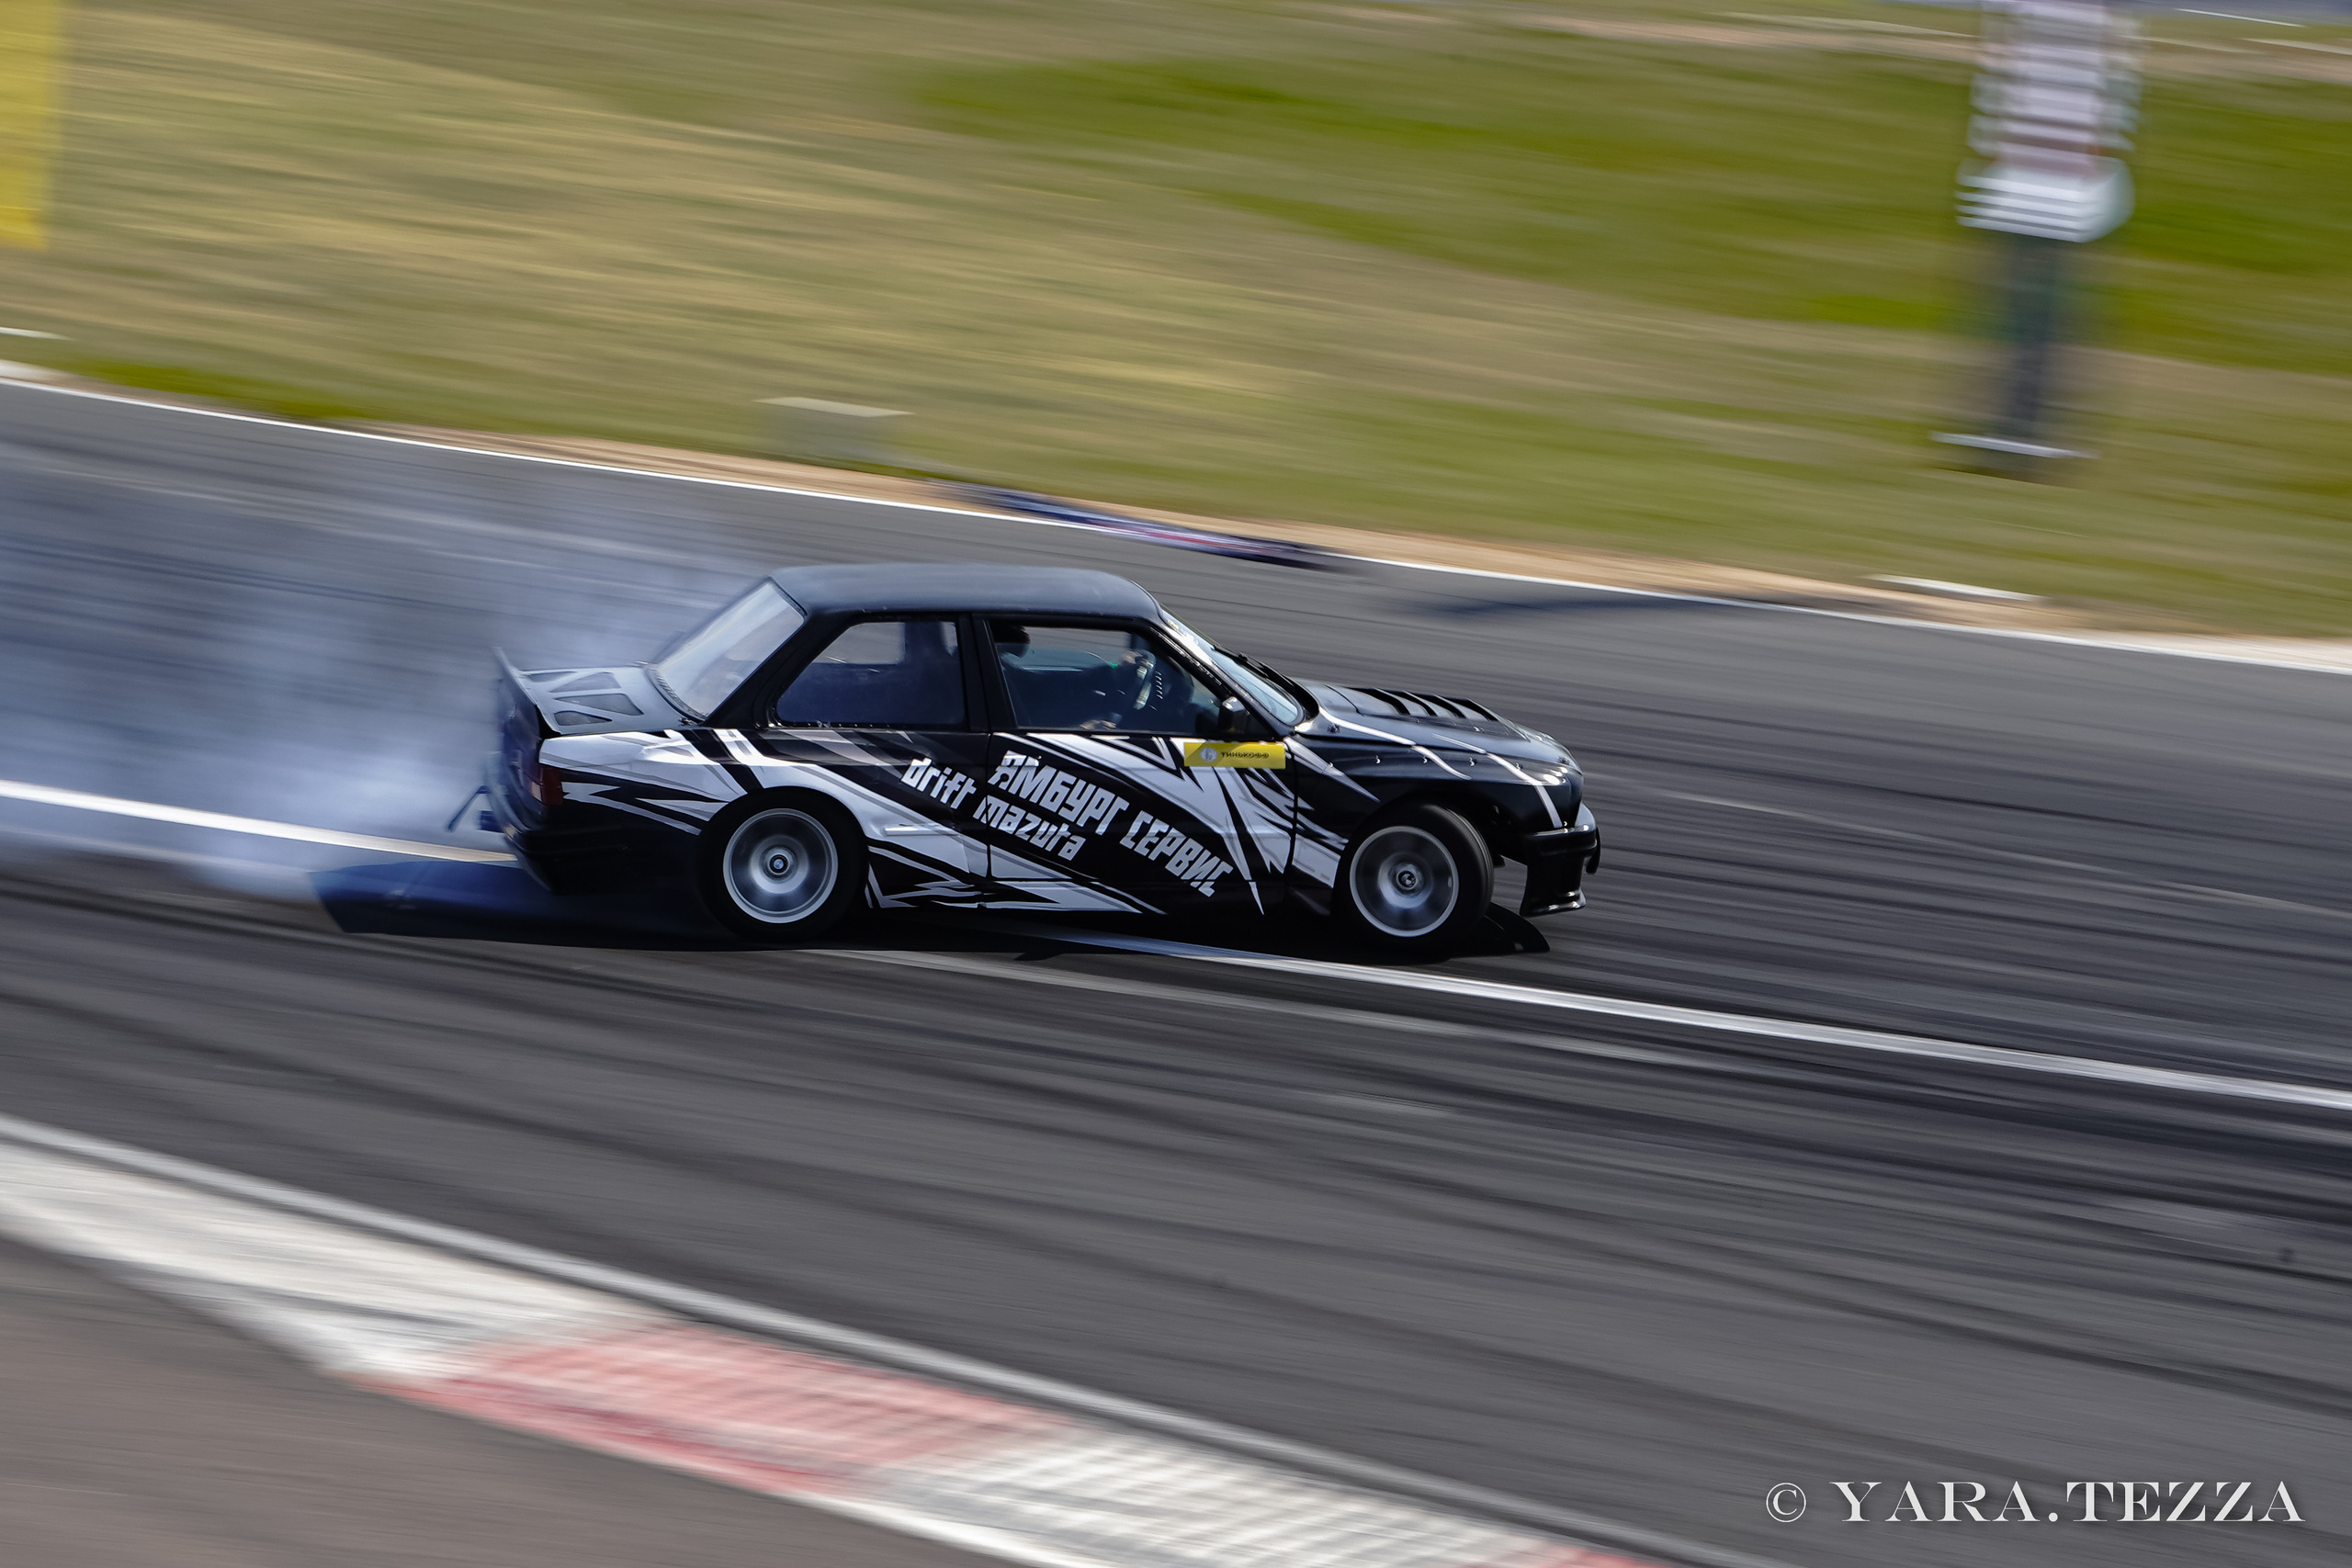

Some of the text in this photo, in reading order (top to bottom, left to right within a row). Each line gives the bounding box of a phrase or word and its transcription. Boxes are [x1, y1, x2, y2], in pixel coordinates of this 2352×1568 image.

[900, 758, 977, 809] drift
[988, 750, 1234, 897] ЯМБУРГ СЕРВИС
